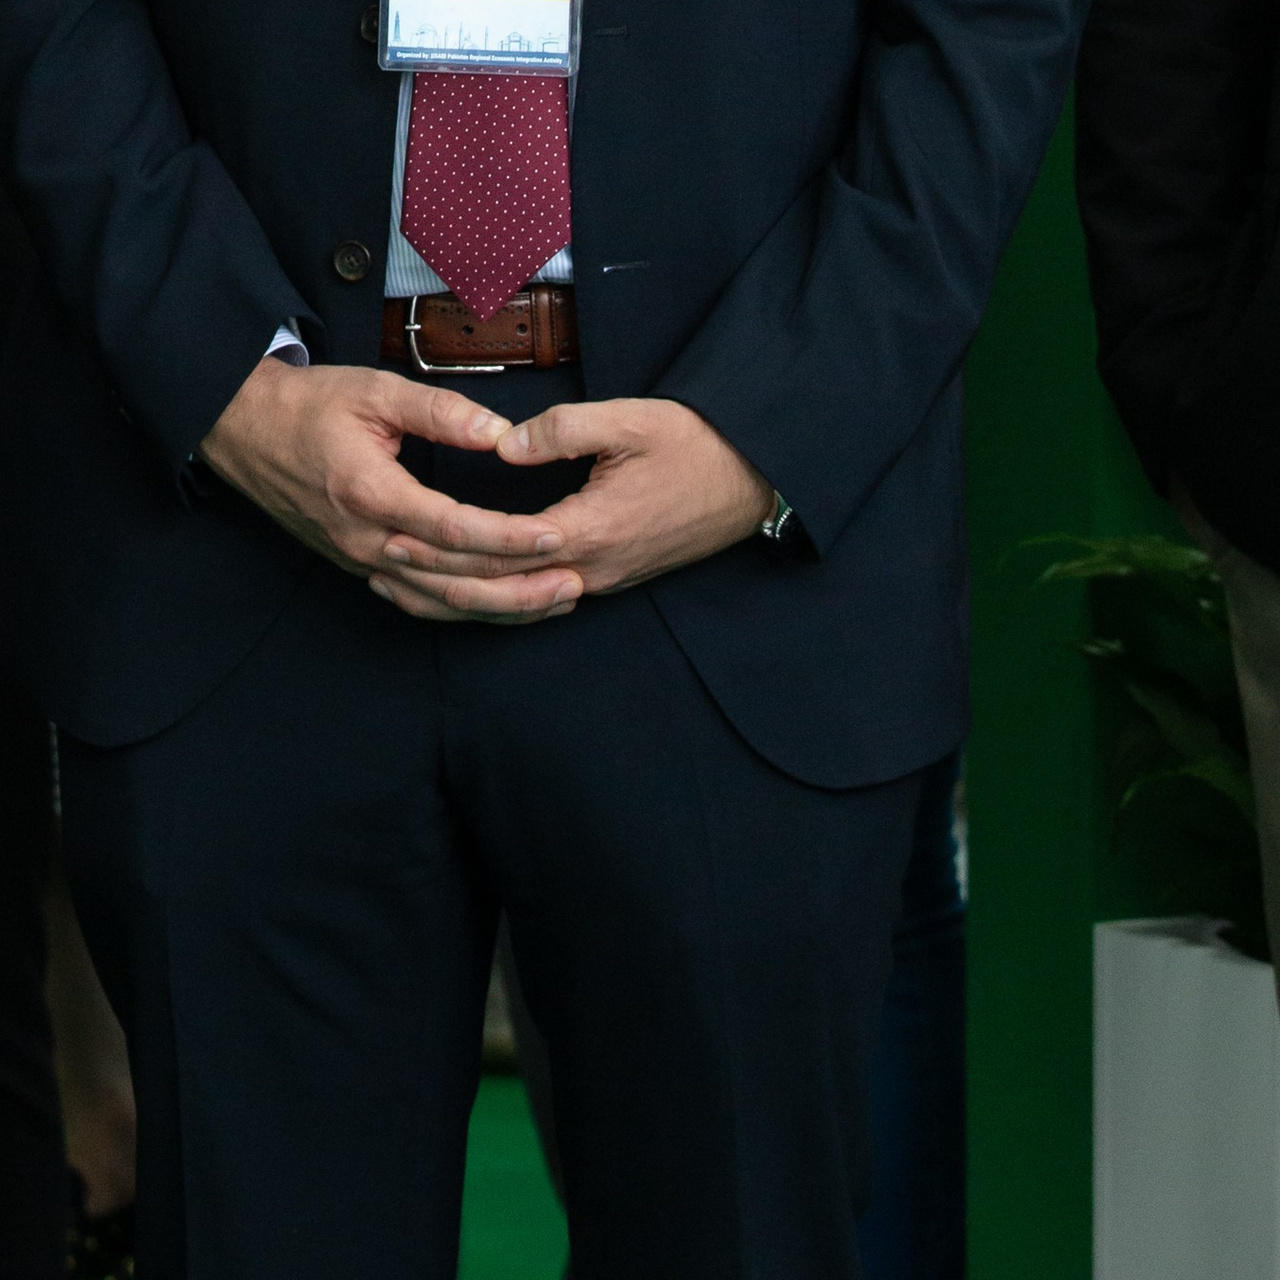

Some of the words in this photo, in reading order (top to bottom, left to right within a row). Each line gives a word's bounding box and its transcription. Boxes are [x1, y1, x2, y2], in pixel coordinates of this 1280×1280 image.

[396, 51, 421, 59] Organized
[469, 54, 491, 62] Regional
[515, 56, 542, 64] Integration
[543, 57, 562, 65] Activity
